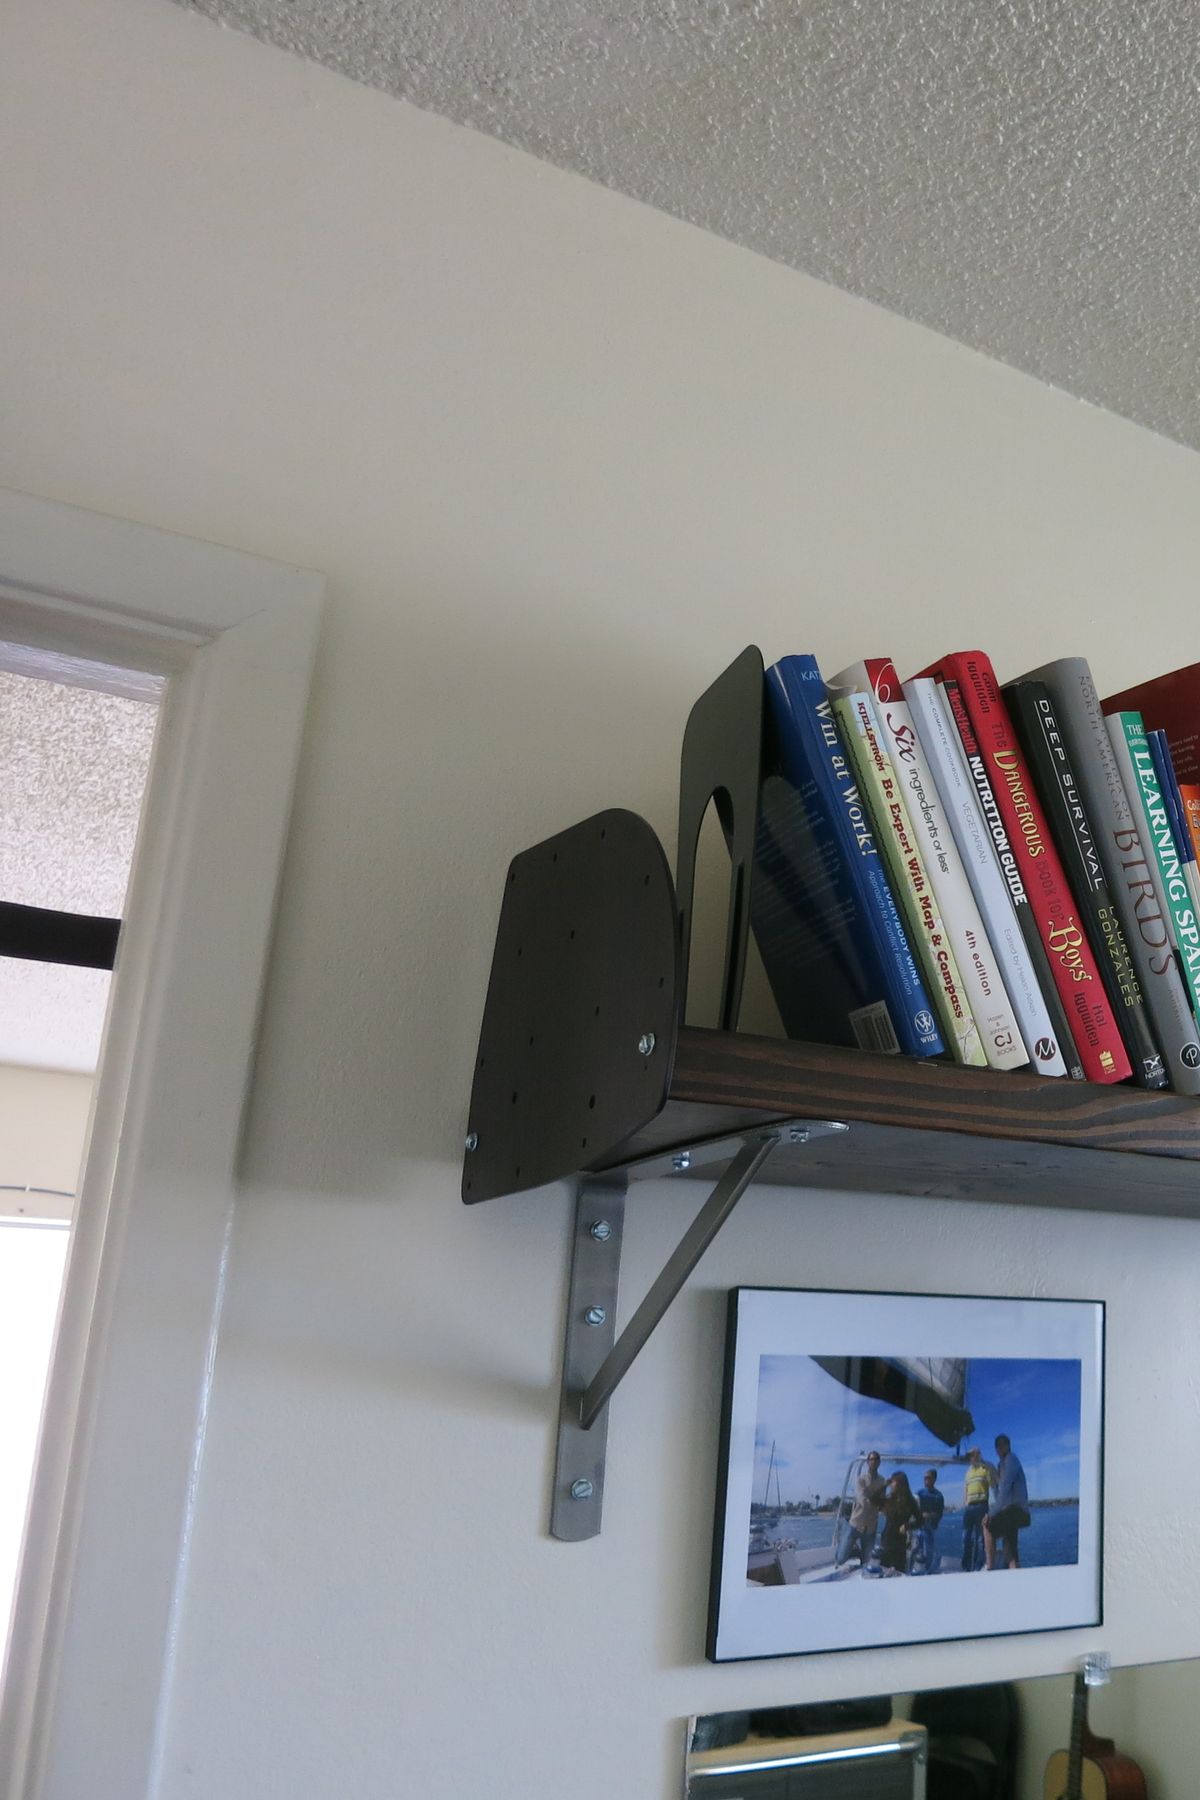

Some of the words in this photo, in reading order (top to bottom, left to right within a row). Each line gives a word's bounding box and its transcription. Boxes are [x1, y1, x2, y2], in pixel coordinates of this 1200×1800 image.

[932, 707, 948, 745] COMPLETE
[1078, 675, 1098, 730] NORTH
[1095, 738, 1124, 820] AMERICAN
[1126, 725, 1143, 736] THE
[815, 700, 837, 748] Win
[832, 755, 849, 780] at
[843, 785, 877, 856] Work!
[882, 778, 893, 799] Be
[886, 712, 916, 763] Six
[909, 768, 938, 839] ingredients
[934, 840, 943, 853] or
[1038, 700, 1066, 761] DEEP
[1062, 774, 1105, 891] SURVIVAL
[890, 803, 913, 854] Expert
[961, 801, 988, 864] VEGETARIAN
[969, 755, 1010, 851] NUTRITION
[1001, 850, 1028, 906] GUIDE
[1134, 750, 1187, 902] LEARNING
[907, 857, 924, 892] With
[919, 895, 935, 930] Map
[1113, 829, 1177, 976] BIRDS
[868, 870, 885, 908] Approach
[881, 909, 888, 918] to
[885, 918, 899, 951] Conflict
[894, 951, 912, 995] Resolution
[883, 886, 910, 952] EVERYBODY
[906, 953, 921, 986] WINS
[932, 934, 943, 947] &
[964, 929, 976, 949] 4th
[973, 953, 992, 996] edition
[1048, 916, 1092, 982] Boys
[1098, 909, 1134, 1007] GONZALES
[1109, 906, 1143, 1004] LAURENCE
[937, 951, 963, 1018] Compass
